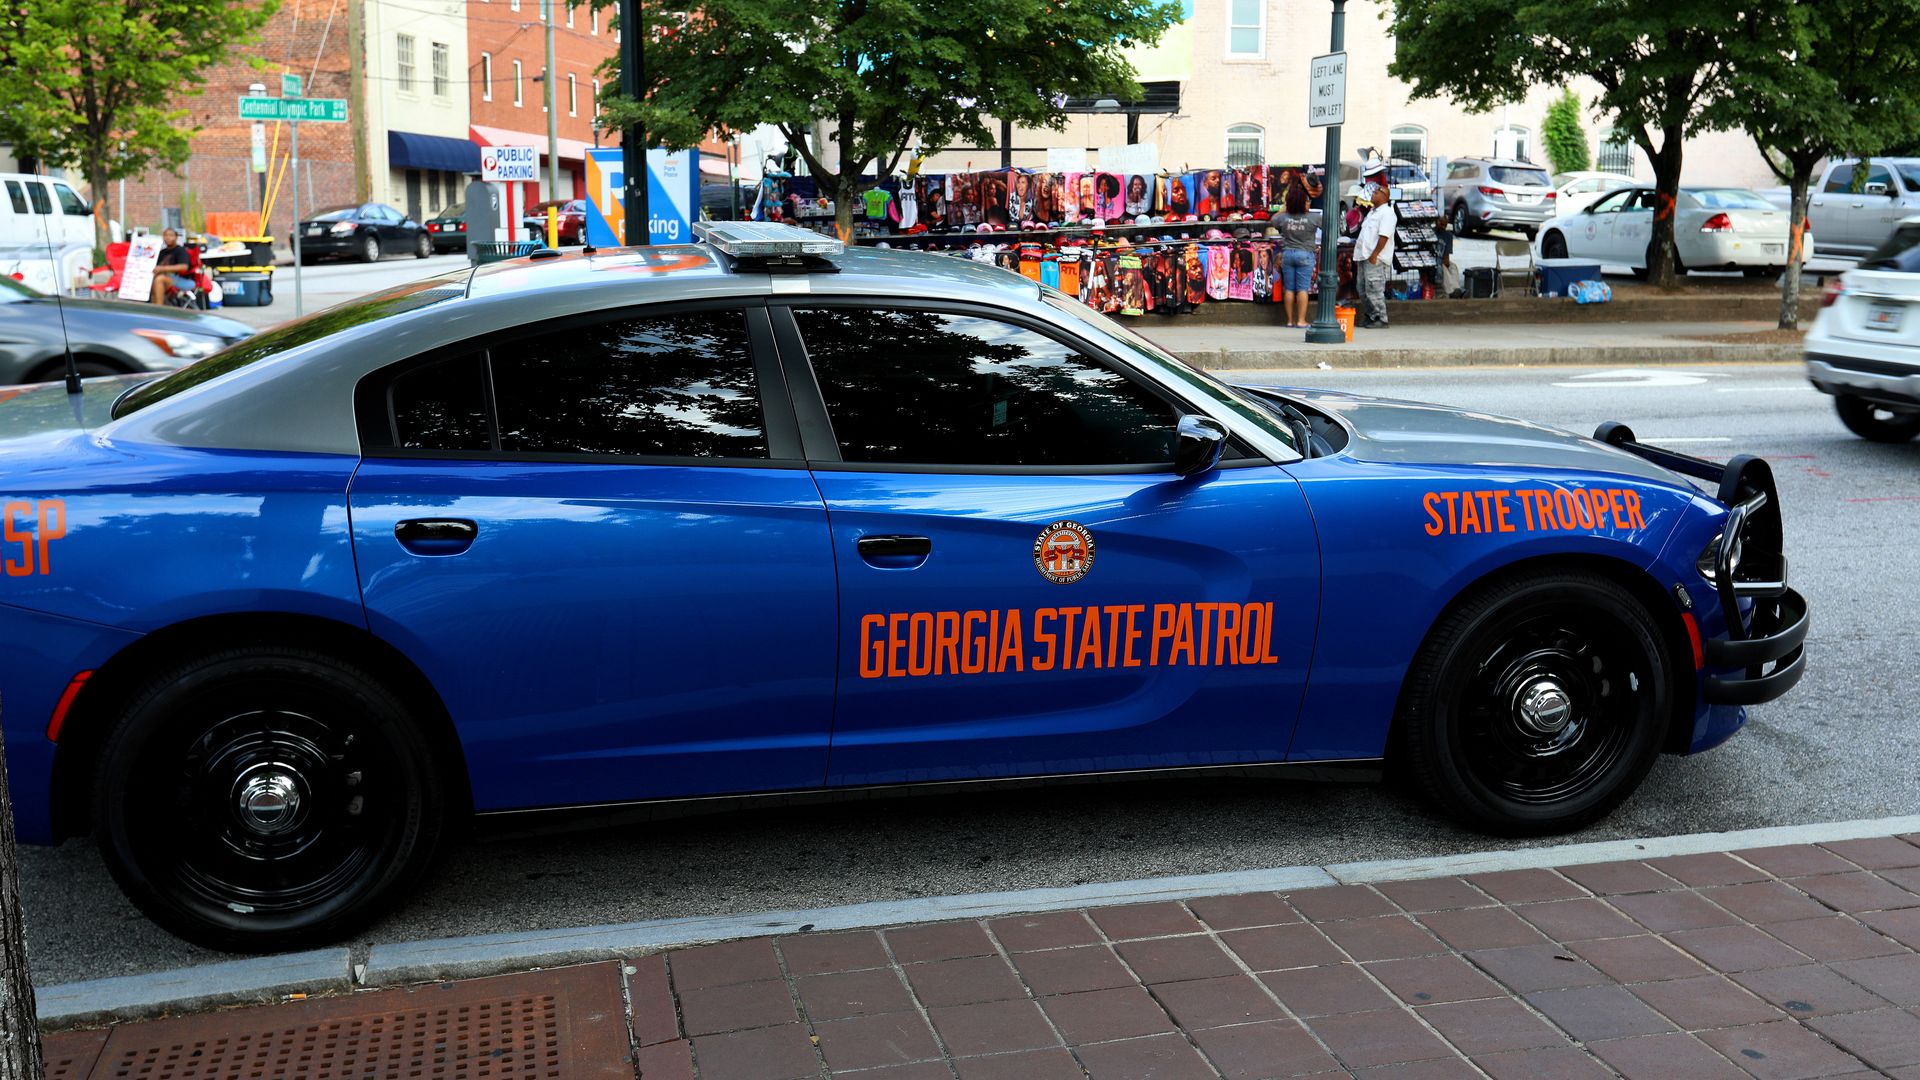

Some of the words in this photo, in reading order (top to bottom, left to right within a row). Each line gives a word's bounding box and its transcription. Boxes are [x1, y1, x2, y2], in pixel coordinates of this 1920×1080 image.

[1313, 65, 1327, 79] LEFT
[1328, 62, 1344, 76] LANE
[1318, 83, 1335, 97] MUST
[241, 98, 278, 115] Centennial
[279, 99, 307, 119] Olympic
[309, 101, 326, 116] Park
[1312, 105, 1327, 118] TURN
[1328, 103, 1342, 116] LEFT
[497, 148, 533, 162] PUBLIC
[486, 156, 495, 171] P
[497, 165, 533, 178] PARKING
[1422, 489, 1516, 537] STATE
[1515, 487, 1647, 531] TROOPER
[0, 499, 66, 576] SP
[1034, 527, 1052, 552] STATE
[1052, 521, 1064, 530] OF
[1066, 521, 1094, 549] GEORGIA
[1066, 570, 1083, 582] PUBLIC
[859, 609, 1024, 679] GEORGIA
[1031, 604, 1145, 671] STATE
[1149, 602, 1278, 667] PATROL
